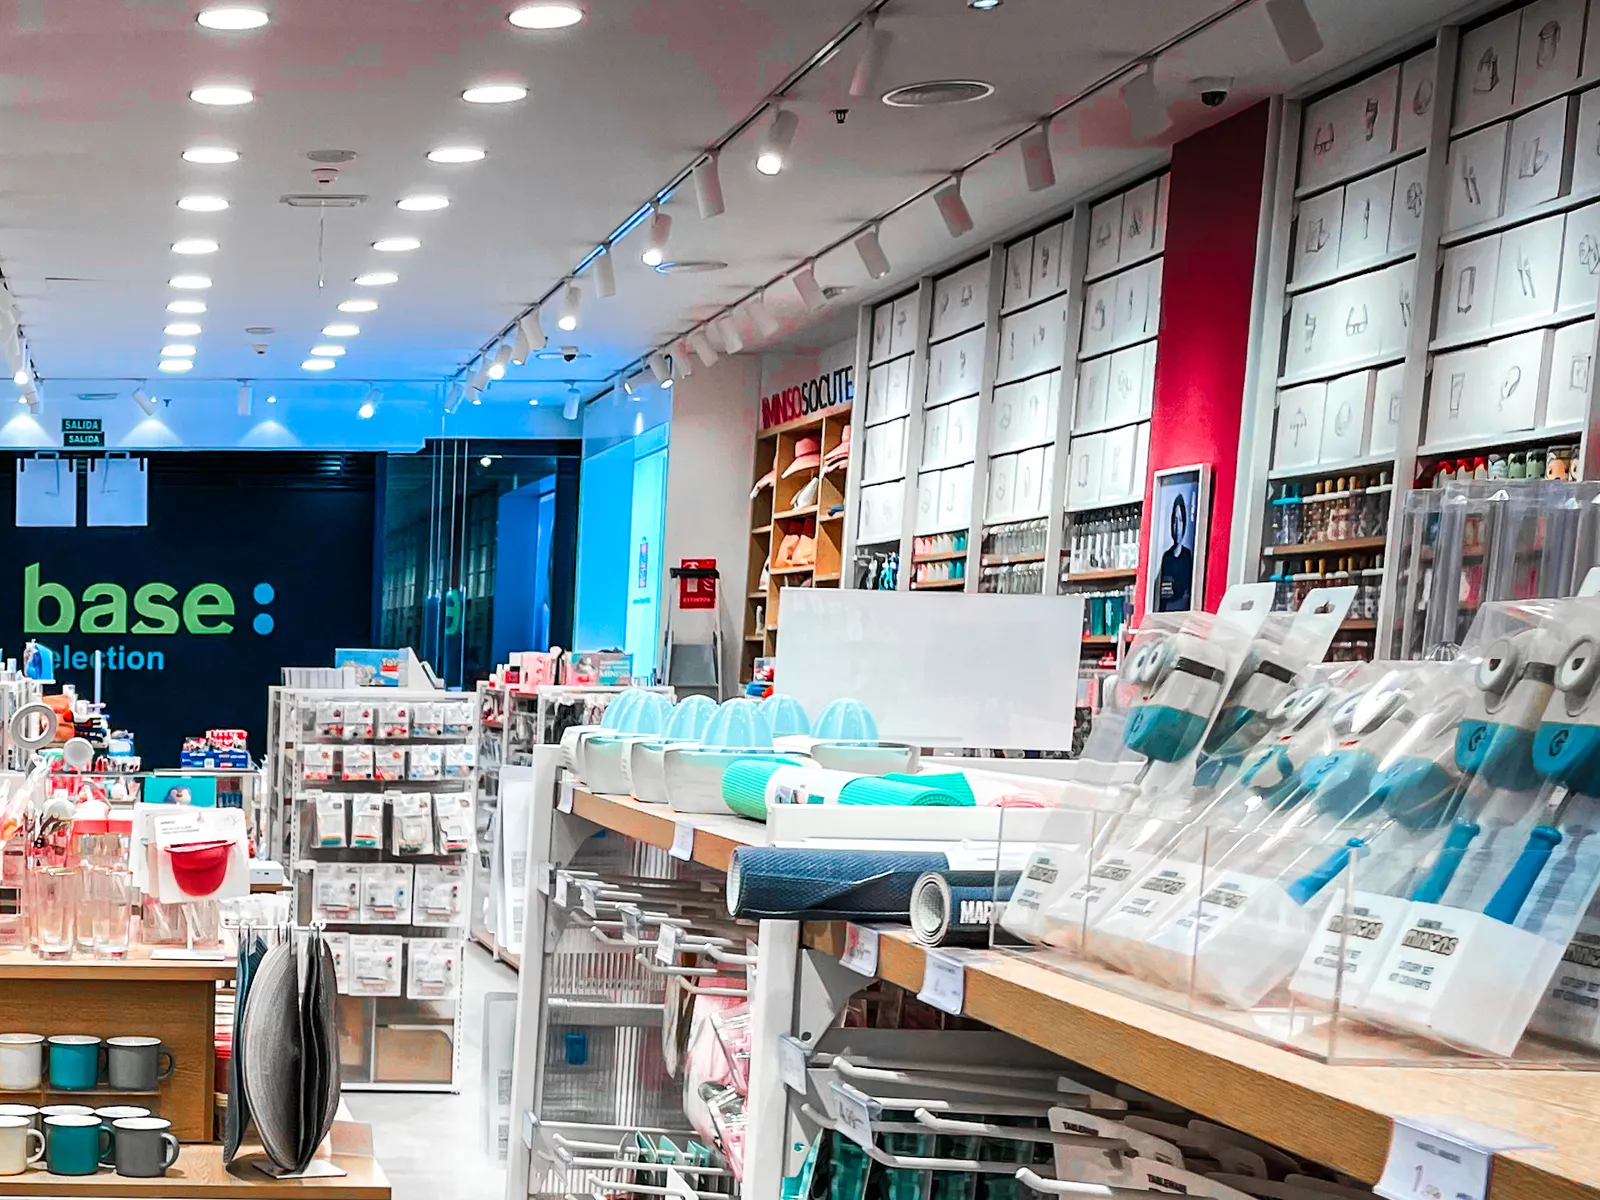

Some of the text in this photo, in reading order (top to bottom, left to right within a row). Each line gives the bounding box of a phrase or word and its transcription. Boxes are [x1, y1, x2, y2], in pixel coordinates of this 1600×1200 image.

[65, 420, 99, 430] SALIDA
[68, 435, 100, 443] SALIDA
[50, 644, 165, 671] election
